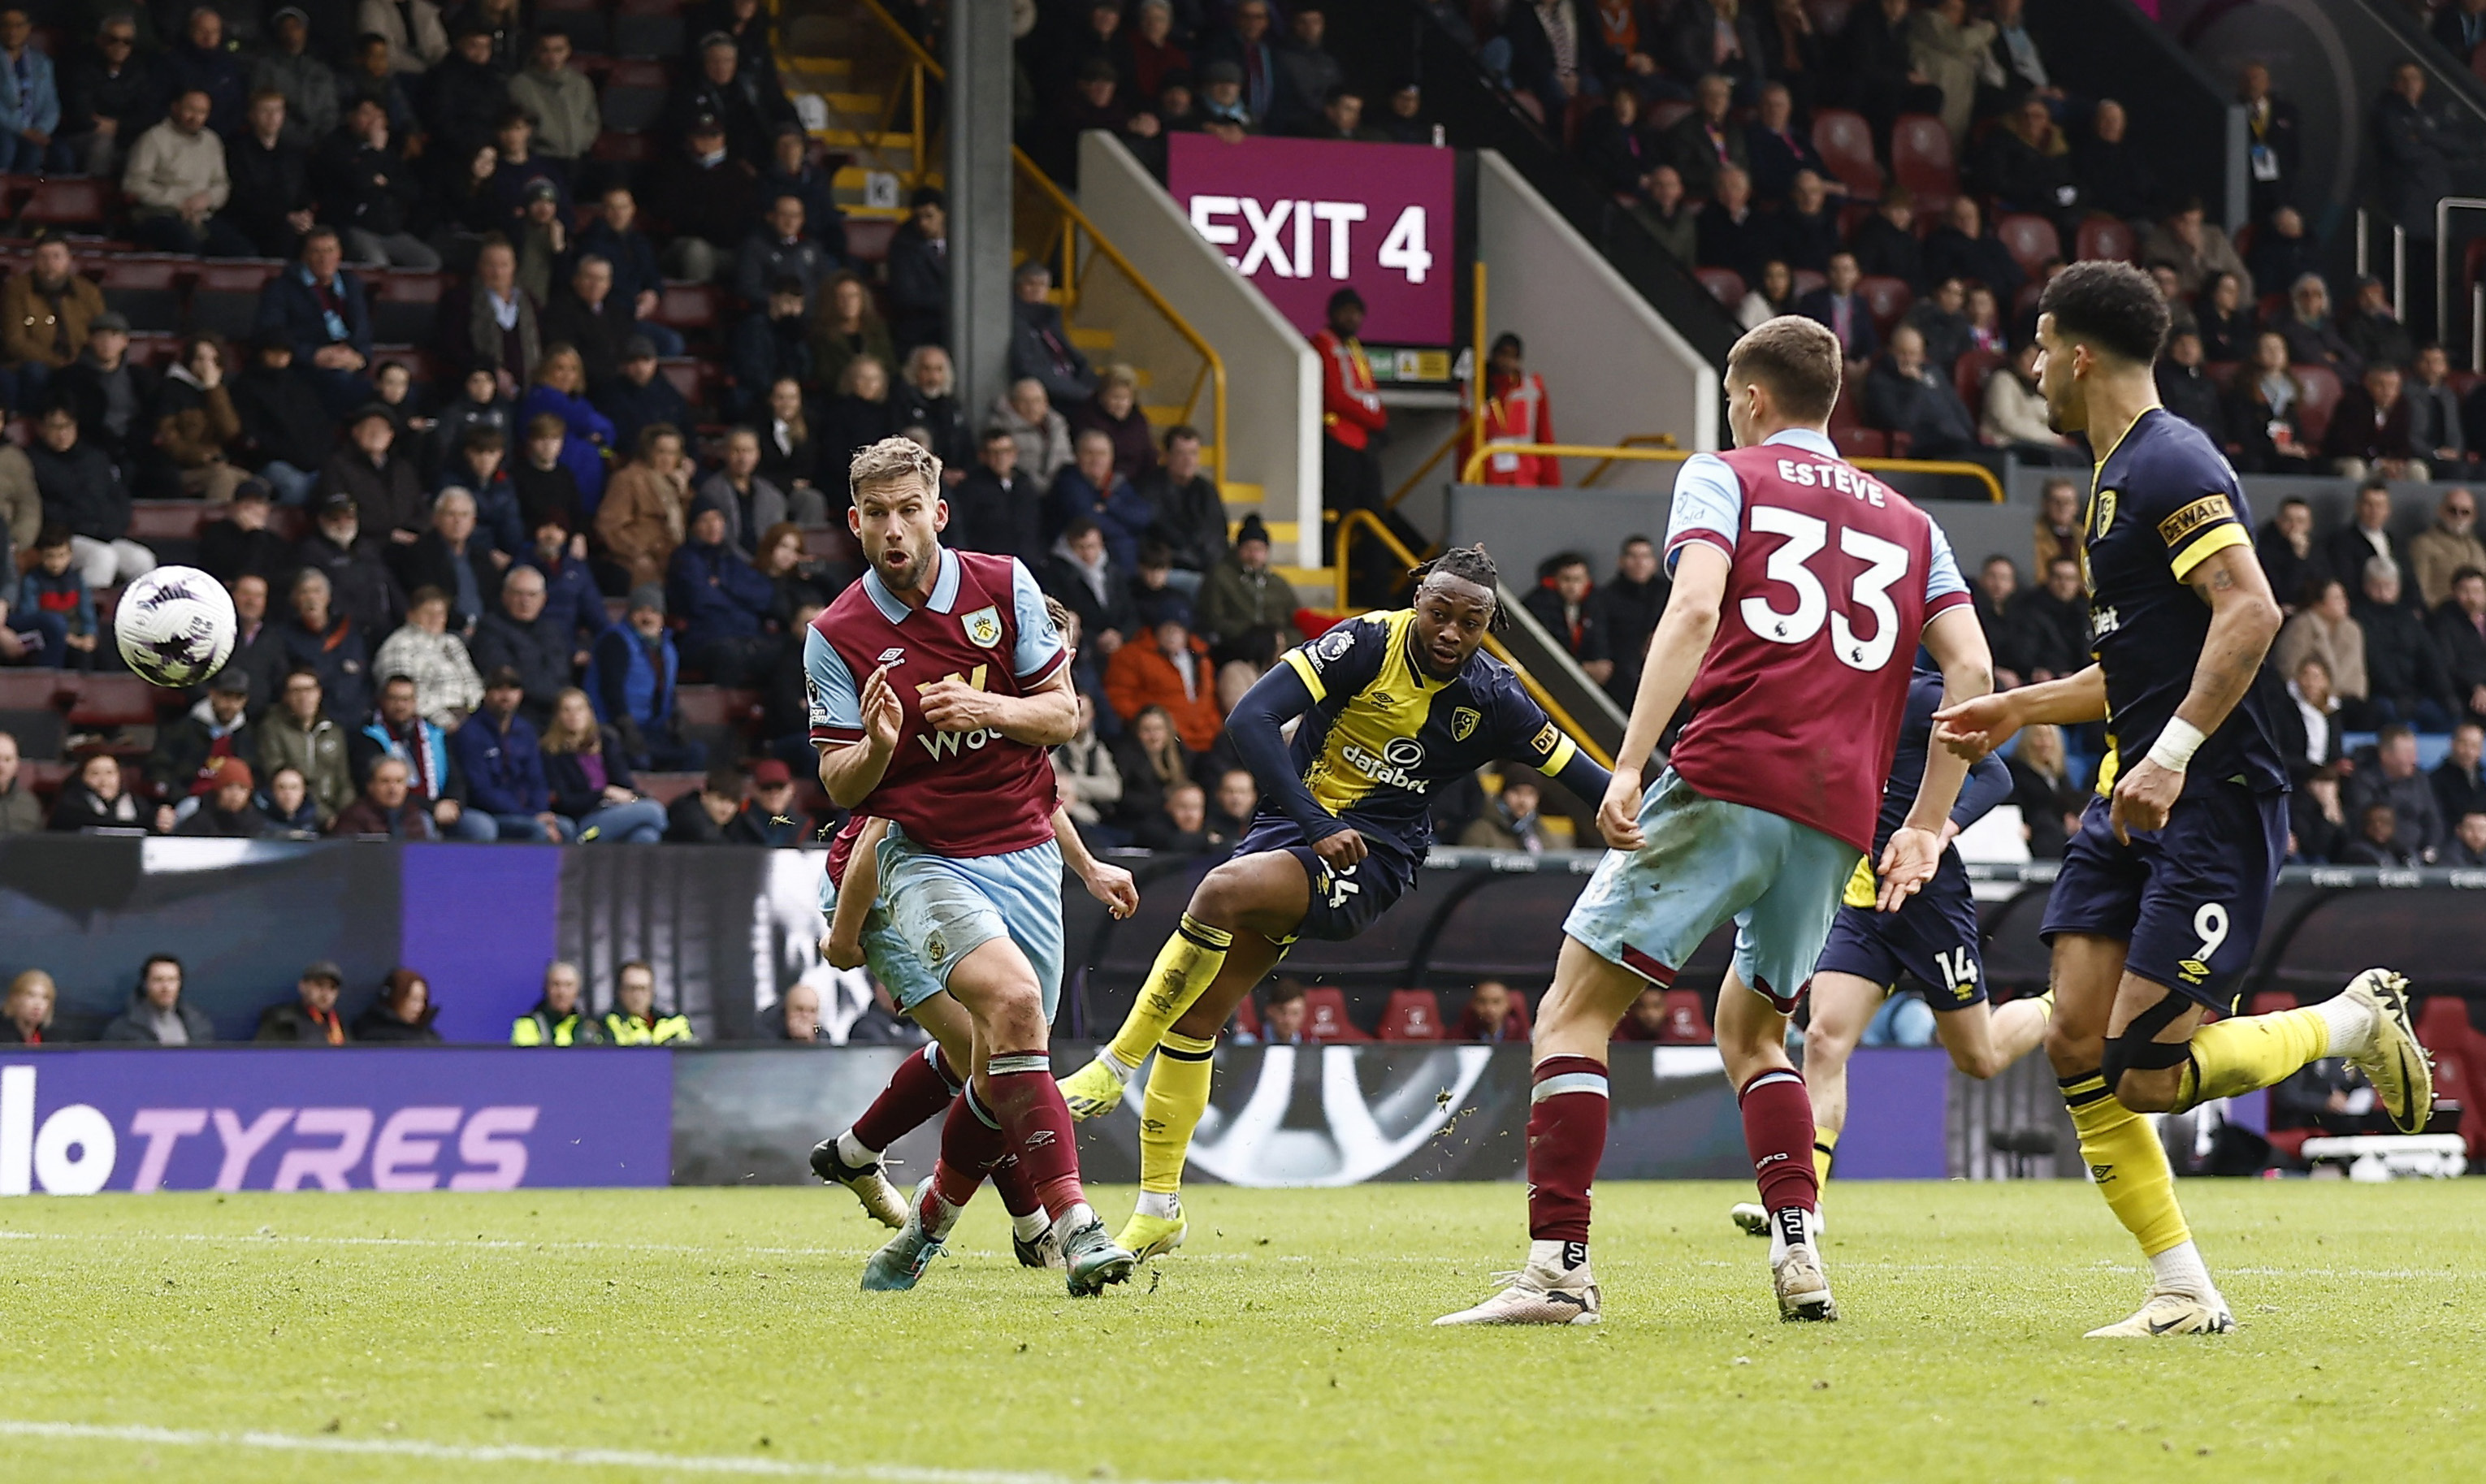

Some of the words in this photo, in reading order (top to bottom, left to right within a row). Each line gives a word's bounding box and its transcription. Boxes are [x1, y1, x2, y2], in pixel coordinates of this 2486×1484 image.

[1189, 194, 1367, 280] EXIT
[1379, 206, 1433, 284] 4
[1740, 505, 1909, 672] 33
[1342, 746, 1430, 794] dafabet
[1934, 945, 1978, 991] 14
[2191, 902, 2229, 963] 9
[130, 1106, 540, 1192] TYRES
